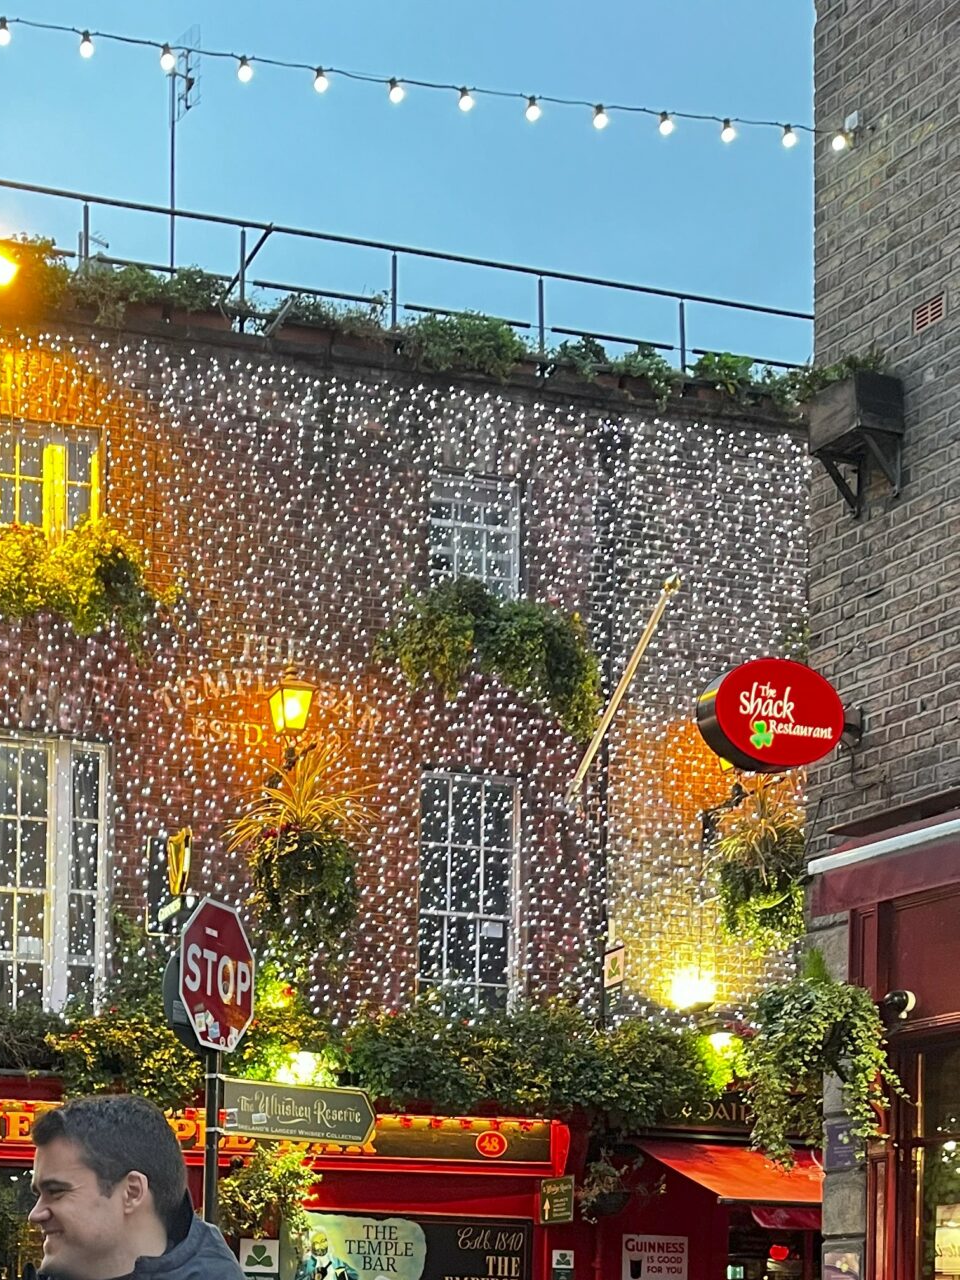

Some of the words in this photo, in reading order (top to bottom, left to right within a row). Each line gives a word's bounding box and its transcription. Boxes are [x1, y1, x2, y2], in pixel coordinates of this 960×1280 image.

[759, 681, 777, 698] The
[739, 681, 795, 728] Shack
[768, 719, 833, 739] Restaurant
[184, 943, 251, 1006] STOP
[237, 1094, 254, 1113] The
[254, 1090, 311, 1125] Whiskey
[313, 1098, 361, 1129] Reserve
[480, 1136, 500, 1152] 48
[362, 1225, 399, 1241] THE
[494, 1232, 524, 1251] 1840
[345, 1240, 414, 1257] TEMPLE
[624, 1238, 685, 1254] GUINNESS
[362, 1257, 397, 1272] BAR
[486, 1255, 521, 1277] THE
[646, 1256, 654, 1264] IS
[657, 1256, 683, 1264] GOOD
[646, 1265, 663, 1274] FOR
[666, 1266, 683, 1275] YOU
